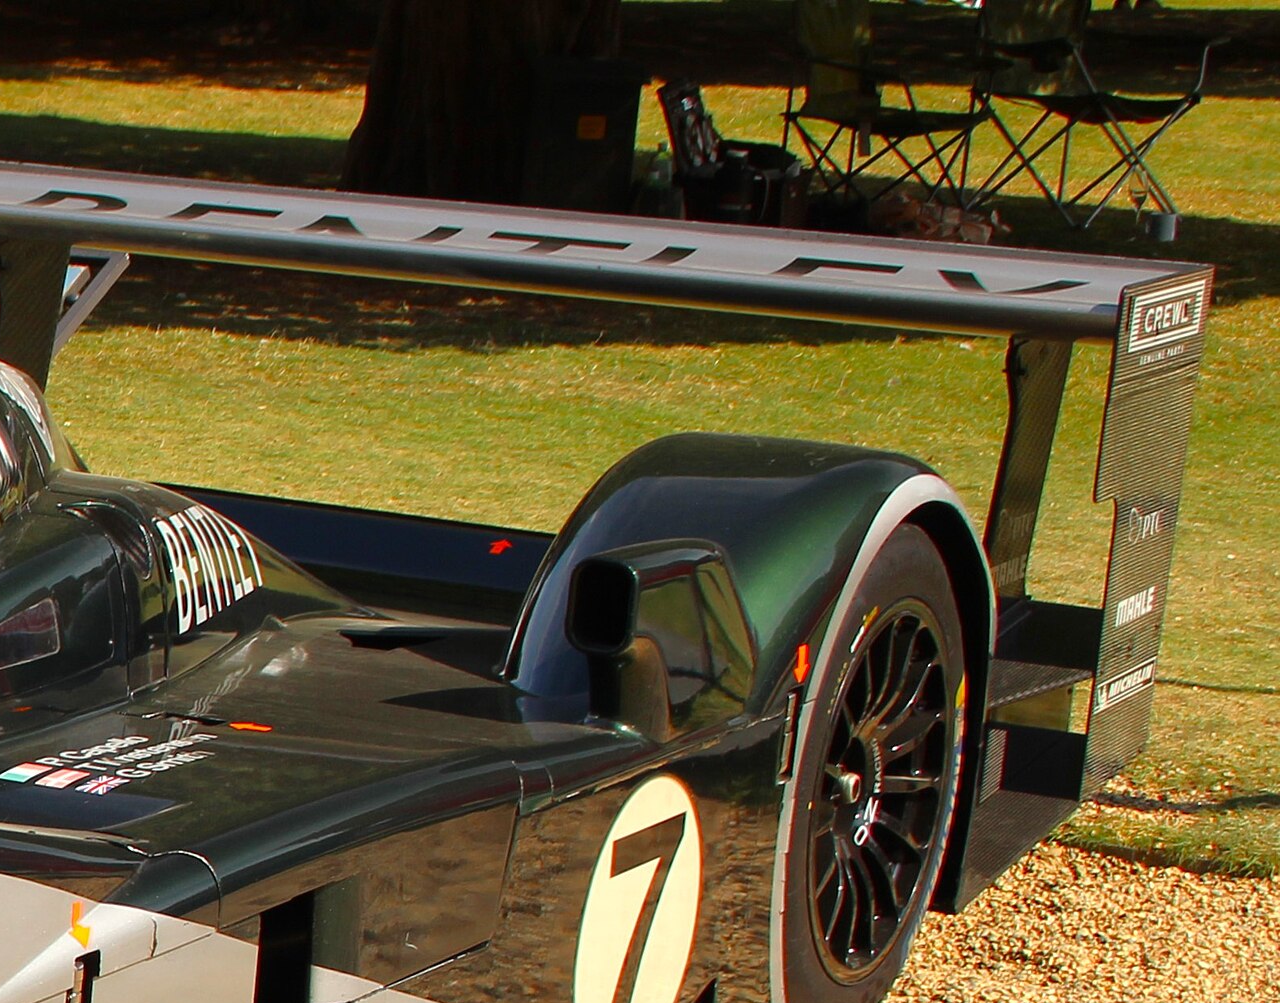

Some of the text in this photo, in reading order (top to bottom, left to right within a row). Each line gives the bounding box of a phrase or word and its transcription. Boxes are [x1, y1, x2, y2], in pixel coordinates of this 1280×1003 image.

[156, 505, 263, 634] BENTLEY
[1115, 586, 1158, 628] MAHLE
[1107, 662, 1154, 699] MICHELIN
